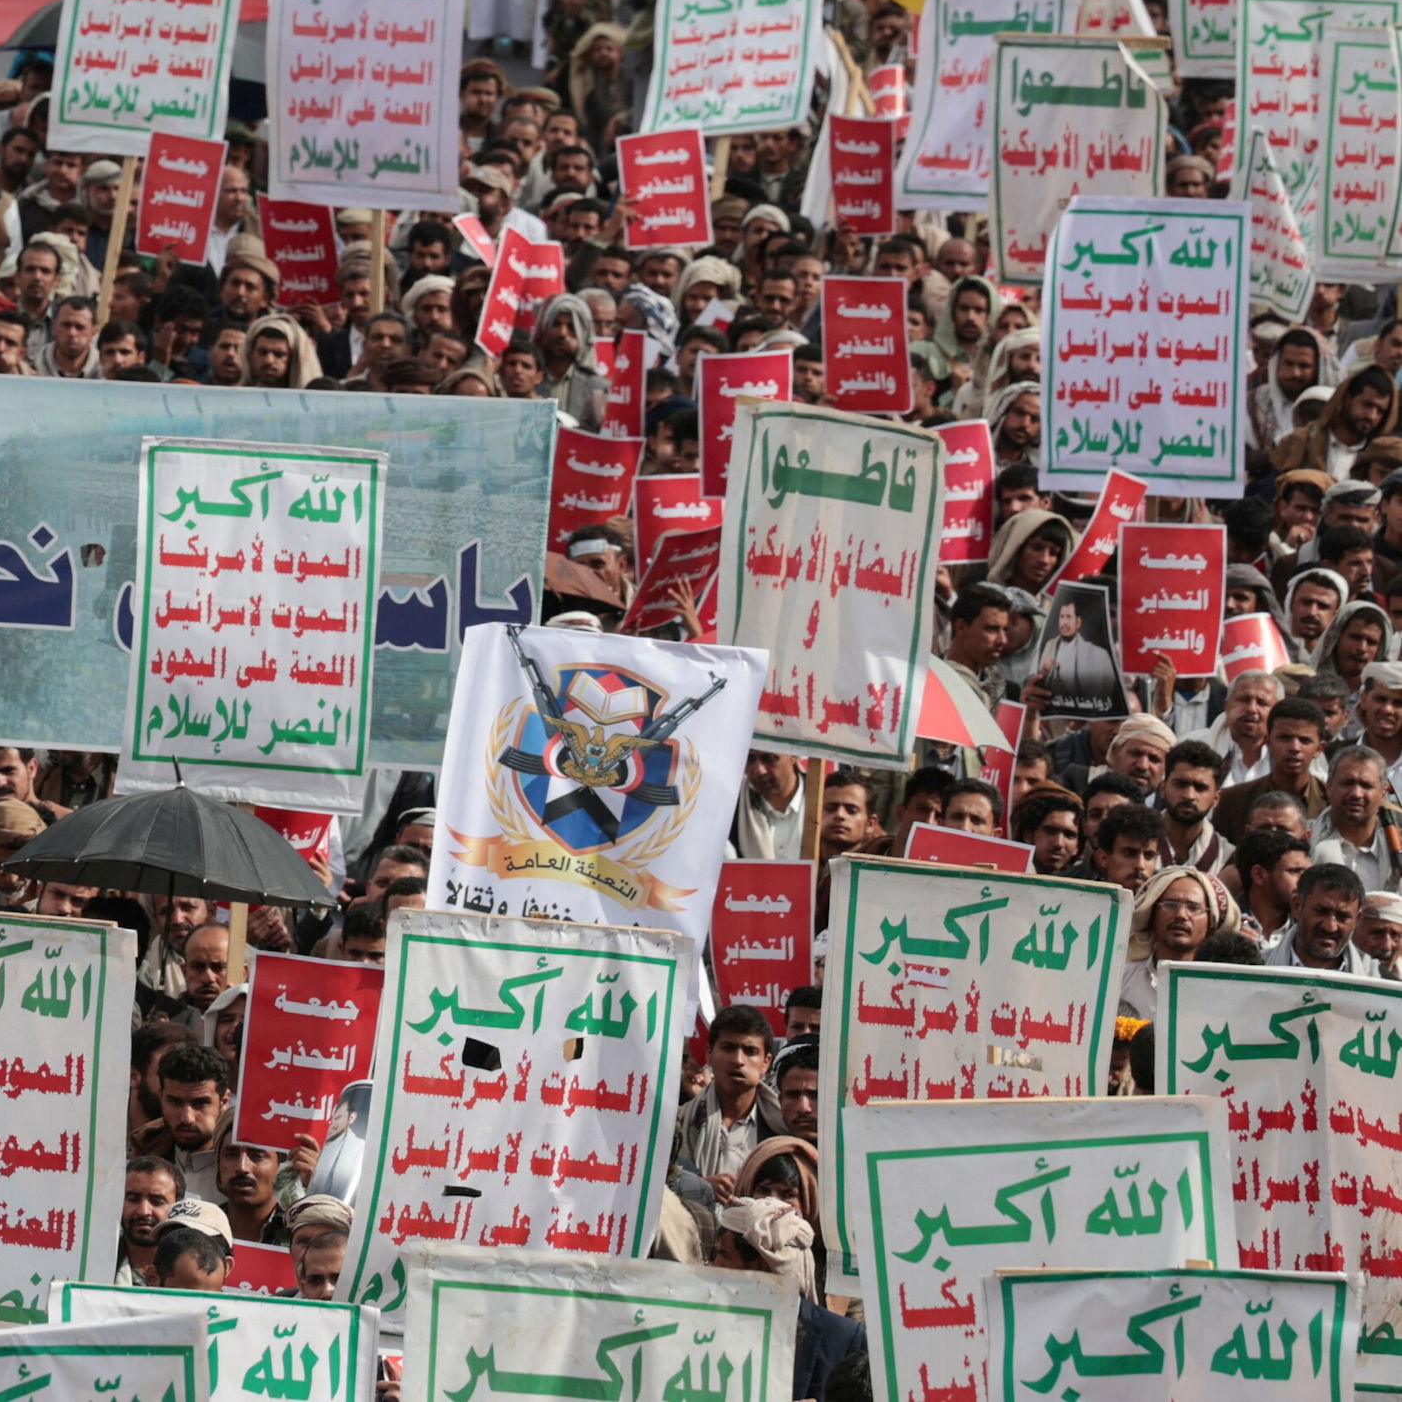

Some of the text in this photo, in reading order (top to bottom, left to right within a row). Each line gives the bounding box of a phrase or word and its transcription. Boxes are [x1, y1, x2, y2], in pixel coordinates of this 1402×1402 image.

[1063, 219, 1233, 278] الله أكبر
[837, 297, 891, 322] جمعة
[1156, 291, 1230, 320] الموت
[835, 336, 894, 358] التحذير
[1156, 338, 1228, 366] الموت
[836, 372, 896, 395] والنفير
[1056, 379, 1226, 411] اللعنة على اليهود
[1151, 419, 1227, 466] النصر
[761, 431, 916, 513] قاطعوا
[162, 465, 363, 529] الله أكبر
[274, 550, 360, 582] الموت
[830, 534, 917, 607] البضائع
[1140, 547, 1207, 574] جمعة
[271, 603, 358, 637] الموت
[1137, 589, 1209, 613] التحذير
[1139, 628, 1205, 657] والنفير
[151, 647, 355, 688] اللعنة على اليهود
[758, 665, 901, 744] الإسرائيل
[260, 700, 352, 755] النصر
[504, 852, 638, 901] التعبئة العامة
[409, 957, 658, 1046] الله أكبر
[540, 1073, 648, 1116] الموت
[530, 1144, 638, 1187] الموت
[480, 1207, 530, 1247] على
[545, 1208, 627, 1254] اللعنة
[891, 1156, 1194, 1272] الله أكبر
[1020, 1282, 1323, 1401] الله أكبر
